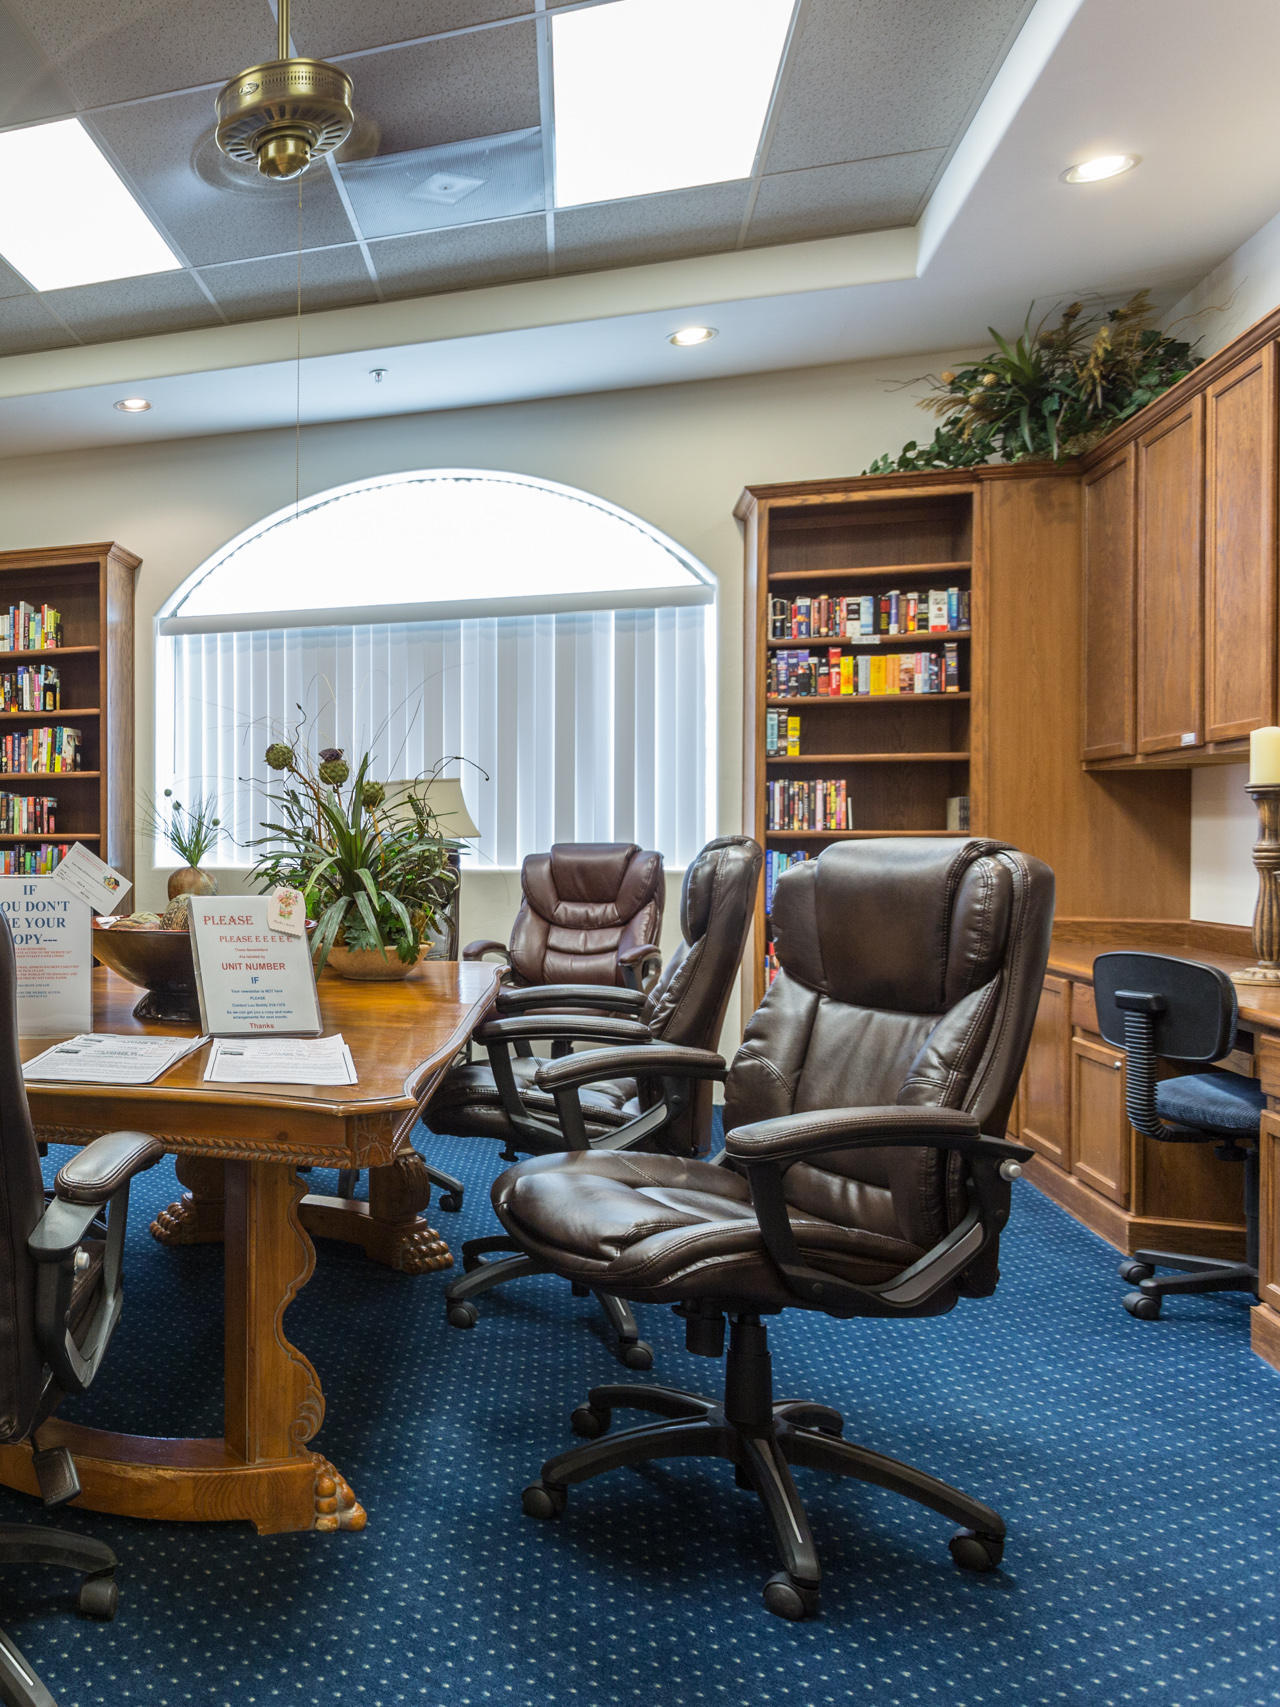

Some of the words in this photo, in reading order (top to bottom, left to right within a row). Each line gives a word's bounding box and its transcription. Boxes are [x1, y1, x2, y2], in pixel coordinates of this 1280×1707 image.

[23, 884, 37, 896] IF
[1, 901, 21, 912] OU
[25, 901, 70, 912] DON'T
[24, 917, 66, 928] YOUR
[203, 915, 254, 926] PLEASE
[13, 934, 58, 945] OPY---
[219, 935, 253, 943] PLEASE
[221, 962, 243, 971] UNIT
[245, 962, 286, 971] NUMBER
[251, 976, 259, 984] IF
